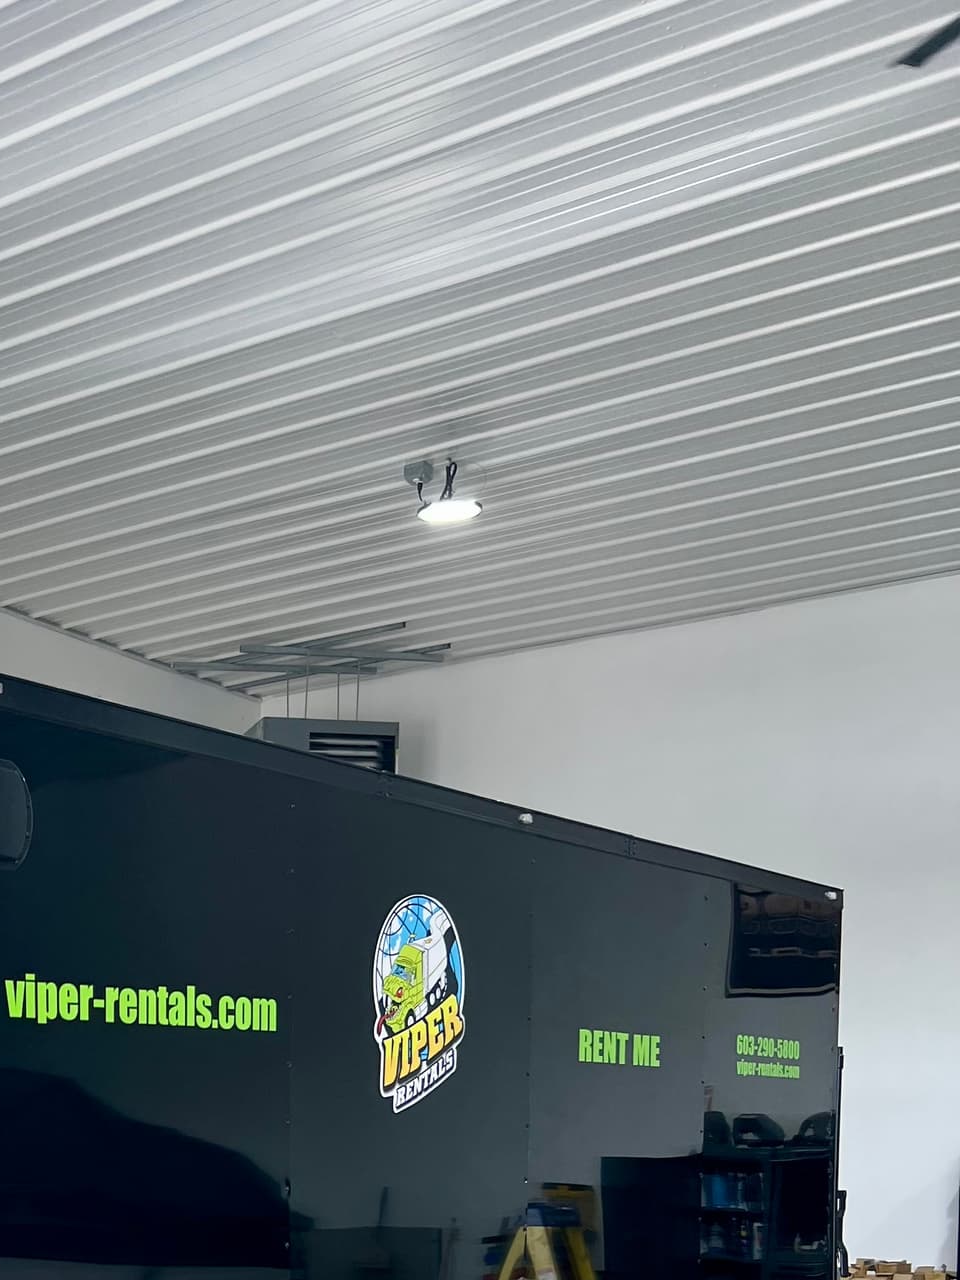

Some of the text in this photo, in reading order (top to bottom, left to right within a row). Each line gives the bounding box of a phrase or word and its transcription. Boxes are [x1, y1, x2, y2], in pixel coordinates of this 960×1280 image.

[5, 973, 277, 1032] viper-rentals.com
[383, 994, 463, 1087] VIPER
[578, 1028, 661, 1067] RENT ME
[736, 1034, 800, 1060] 603-290-5800
[396, 1048, 455, 1107] RENTALS
